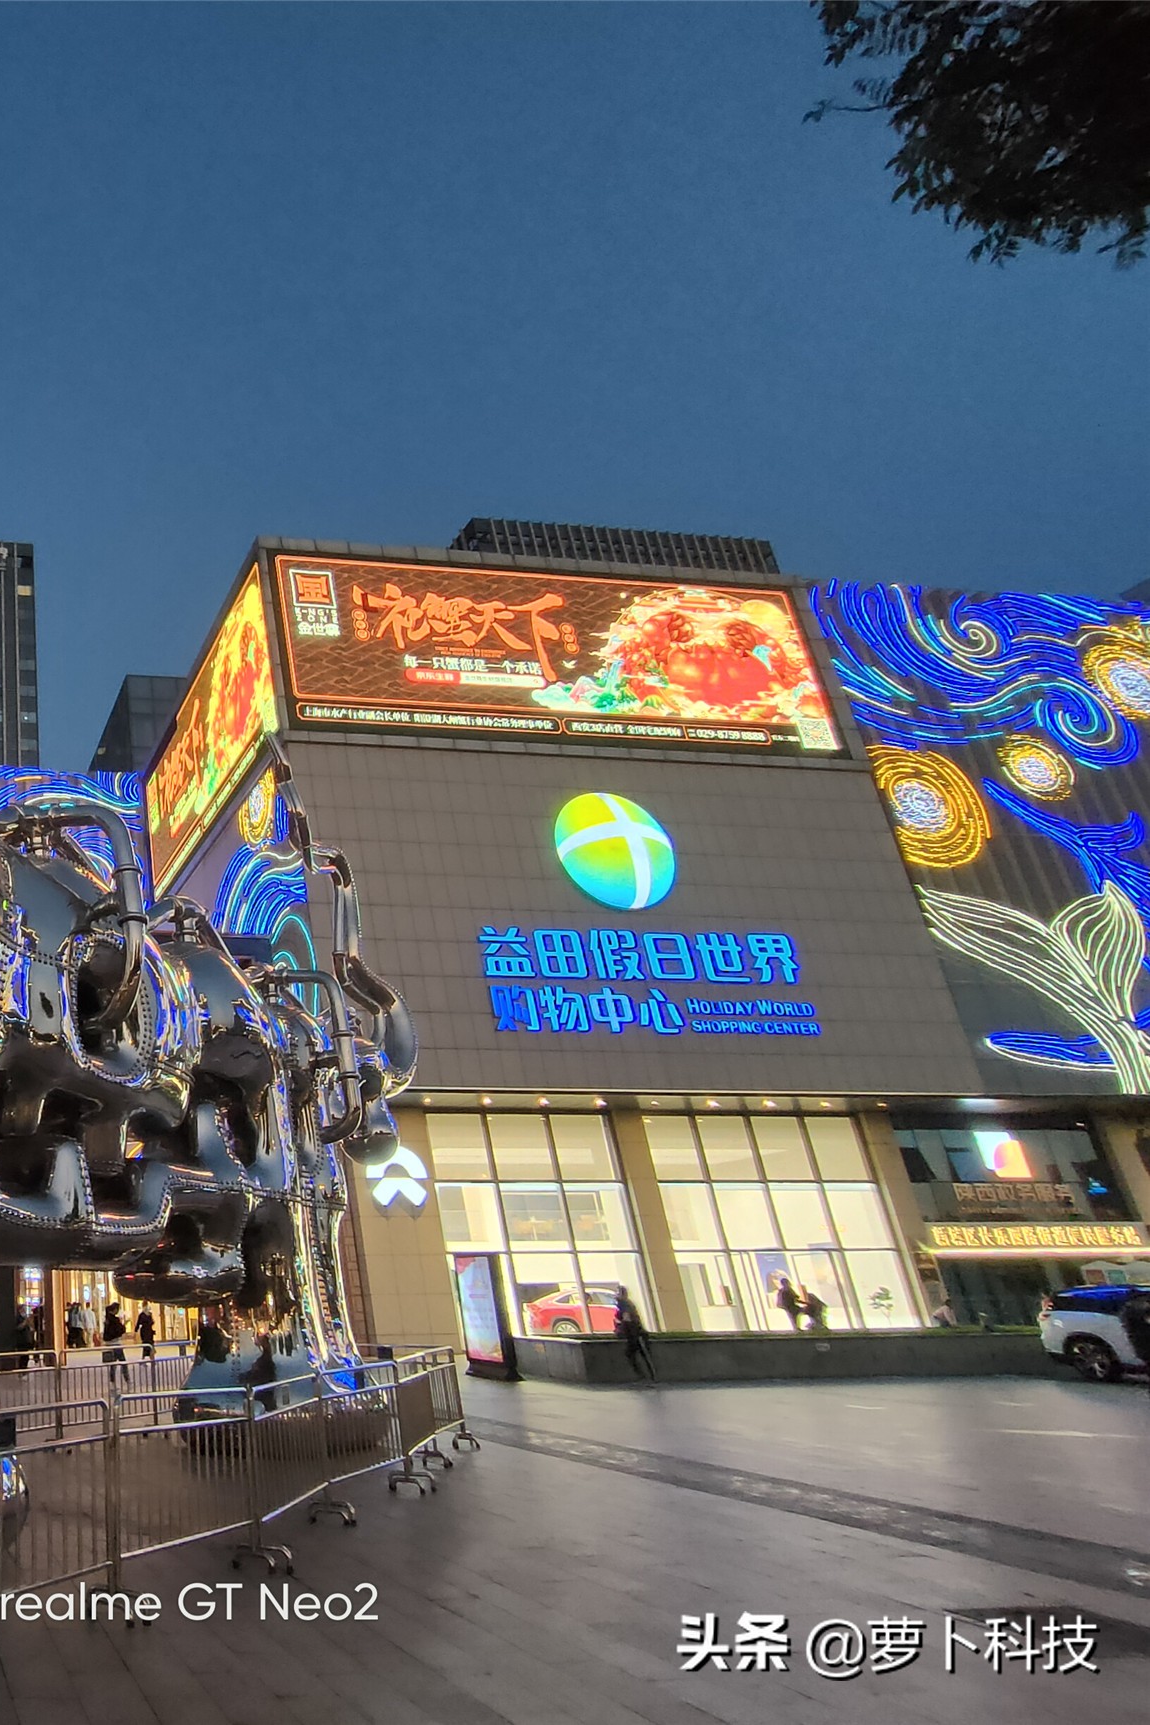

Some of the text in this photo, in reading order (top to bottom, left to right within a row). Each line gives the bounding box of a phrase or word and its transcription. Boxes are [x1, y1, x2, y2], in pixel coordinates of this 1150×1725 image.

[403, 654, 543, 676] 每一只蟹都是一个承诺
[478, 925, 799, 985] 益田假日世界
[489, 985, 685, 1035] 购物中心
[686, 998, 816, 1018] HOLIDAY WORLD
[691, 1019, 823, 1036] SHOPPING CENTER
